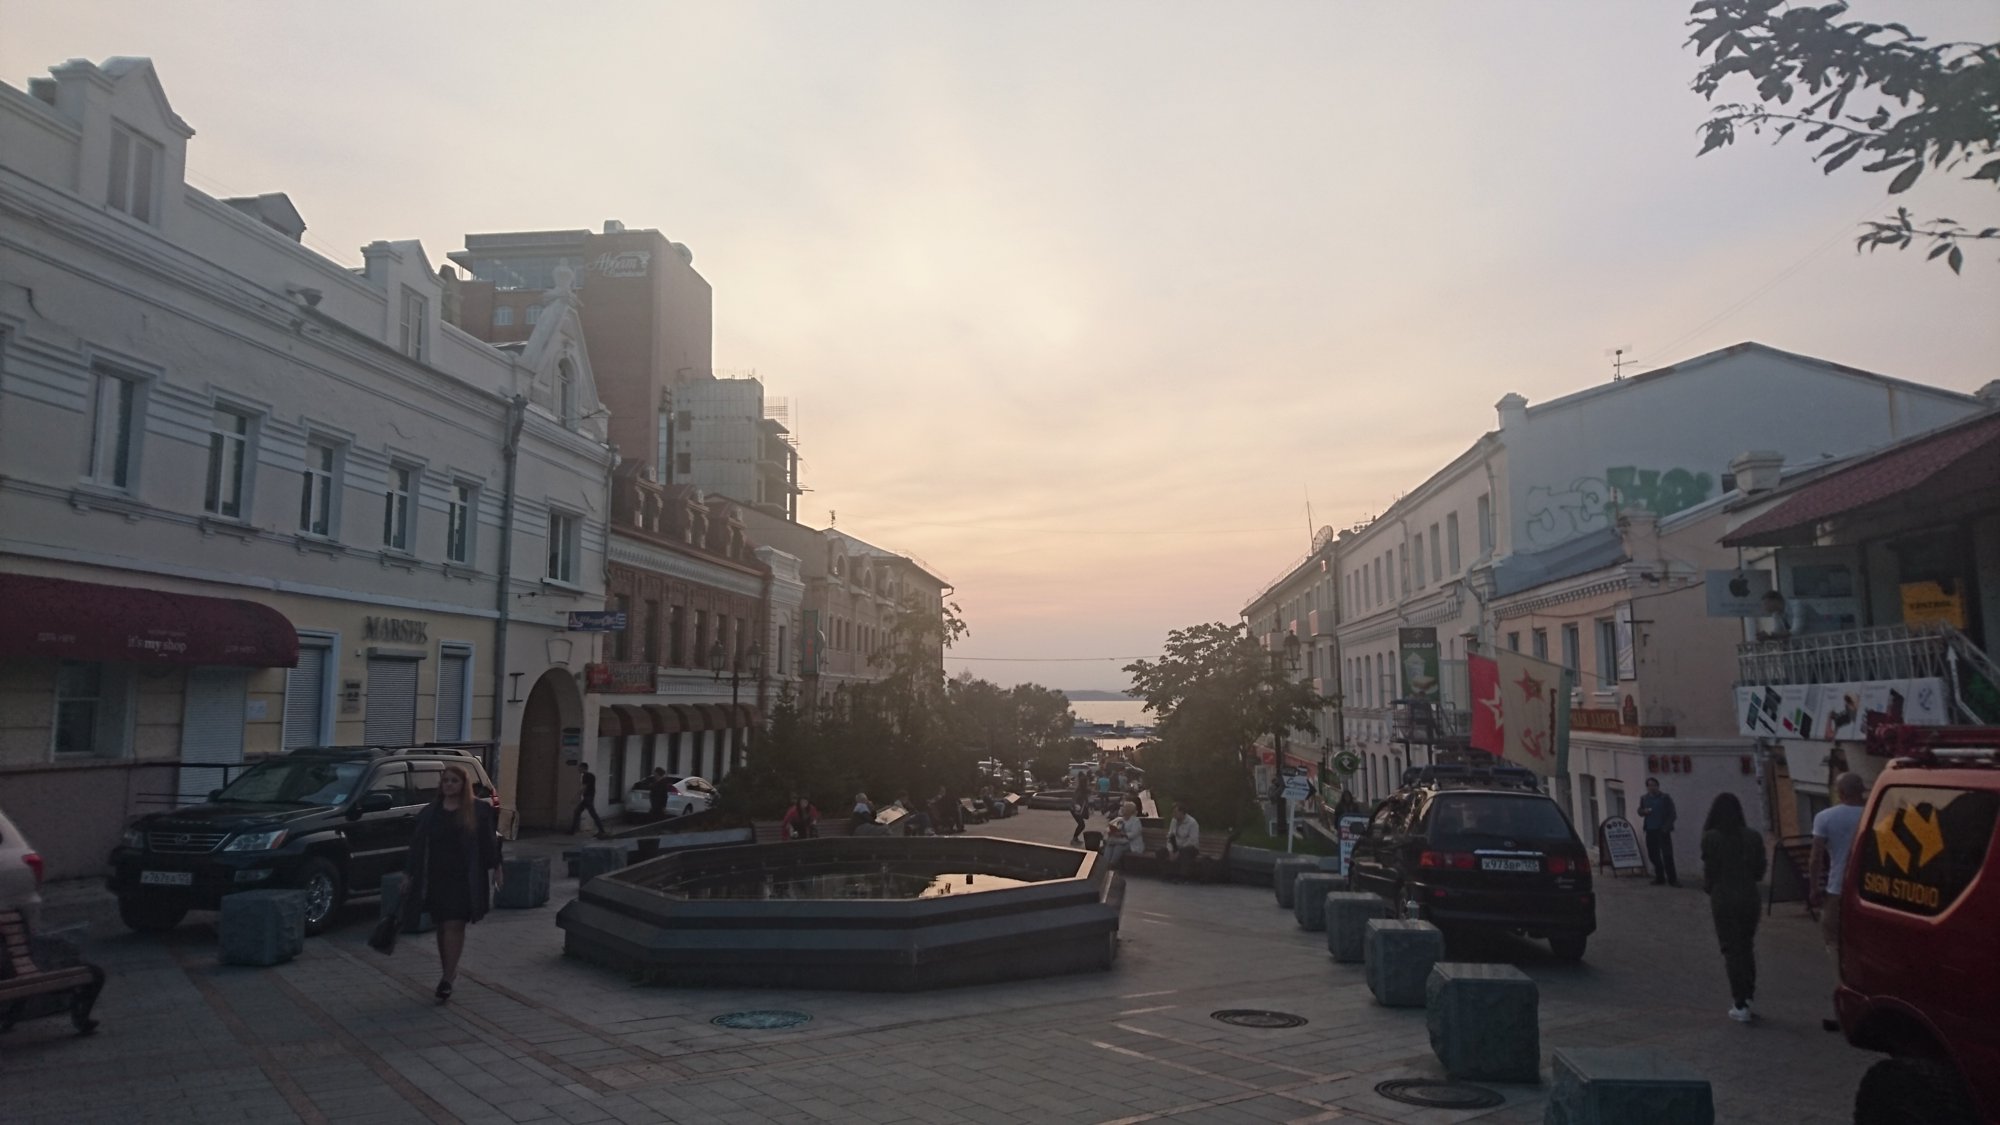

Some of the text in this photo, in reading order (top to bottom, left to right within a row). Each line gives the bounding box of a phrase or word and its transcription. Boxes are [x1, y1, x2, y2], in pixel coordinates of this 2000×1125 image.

[144, 639, 161, 653] my
[163, 639, 187, 654] shop
[1864, 872, 1940, 909] SIGN STUDIO
